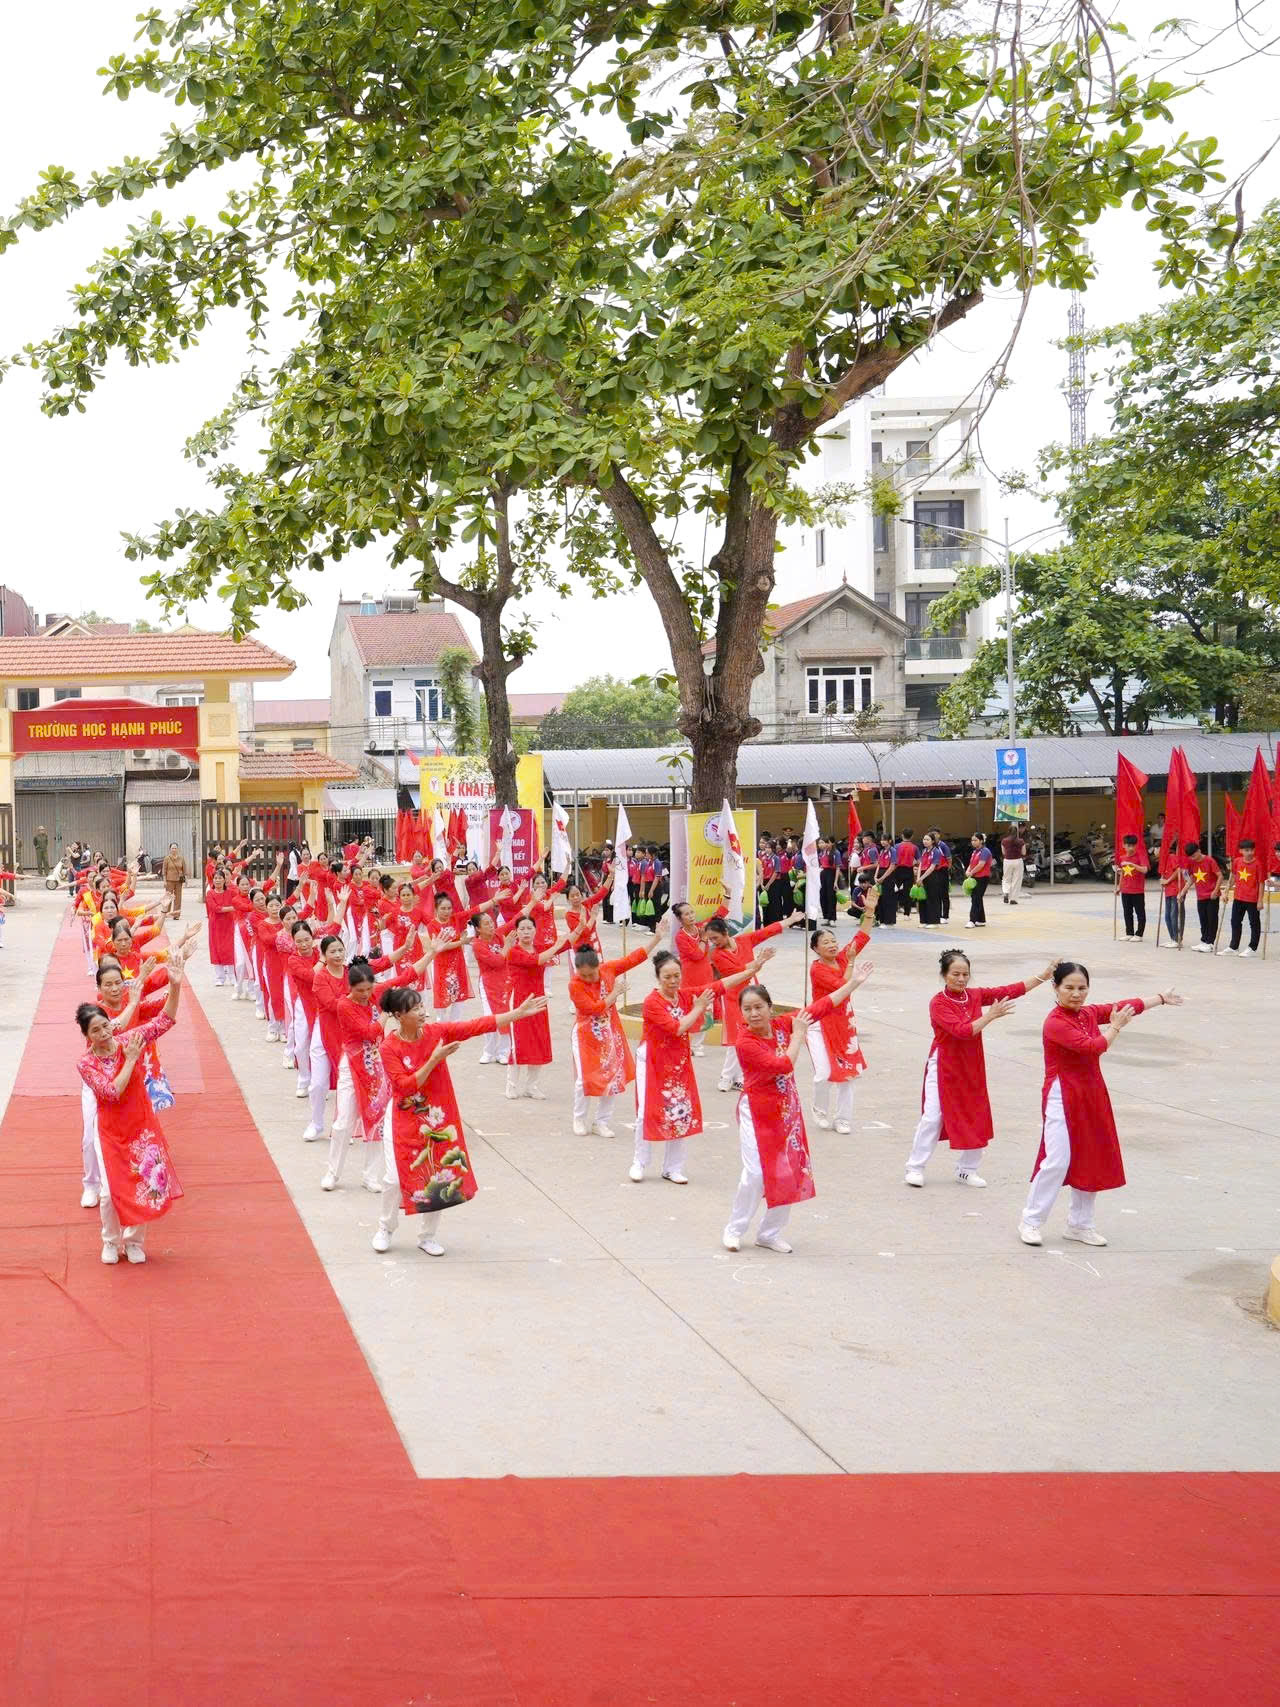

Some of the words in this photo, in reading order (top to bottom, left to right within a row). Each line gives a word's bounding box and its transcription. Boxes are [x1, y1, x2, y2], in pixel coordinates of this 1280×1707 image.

[28, 719, 77, 738] TRƯỜNG
[82, 724, 107, 740] HỌC
[111, 722, 145, 739] HẠNH
[150, 718, 182, 735] PHÚC
[458, 783, 484, 797] KHAI
[512, 838, 526, 847] HAO
[513, 850, 526, 861] KẾT
